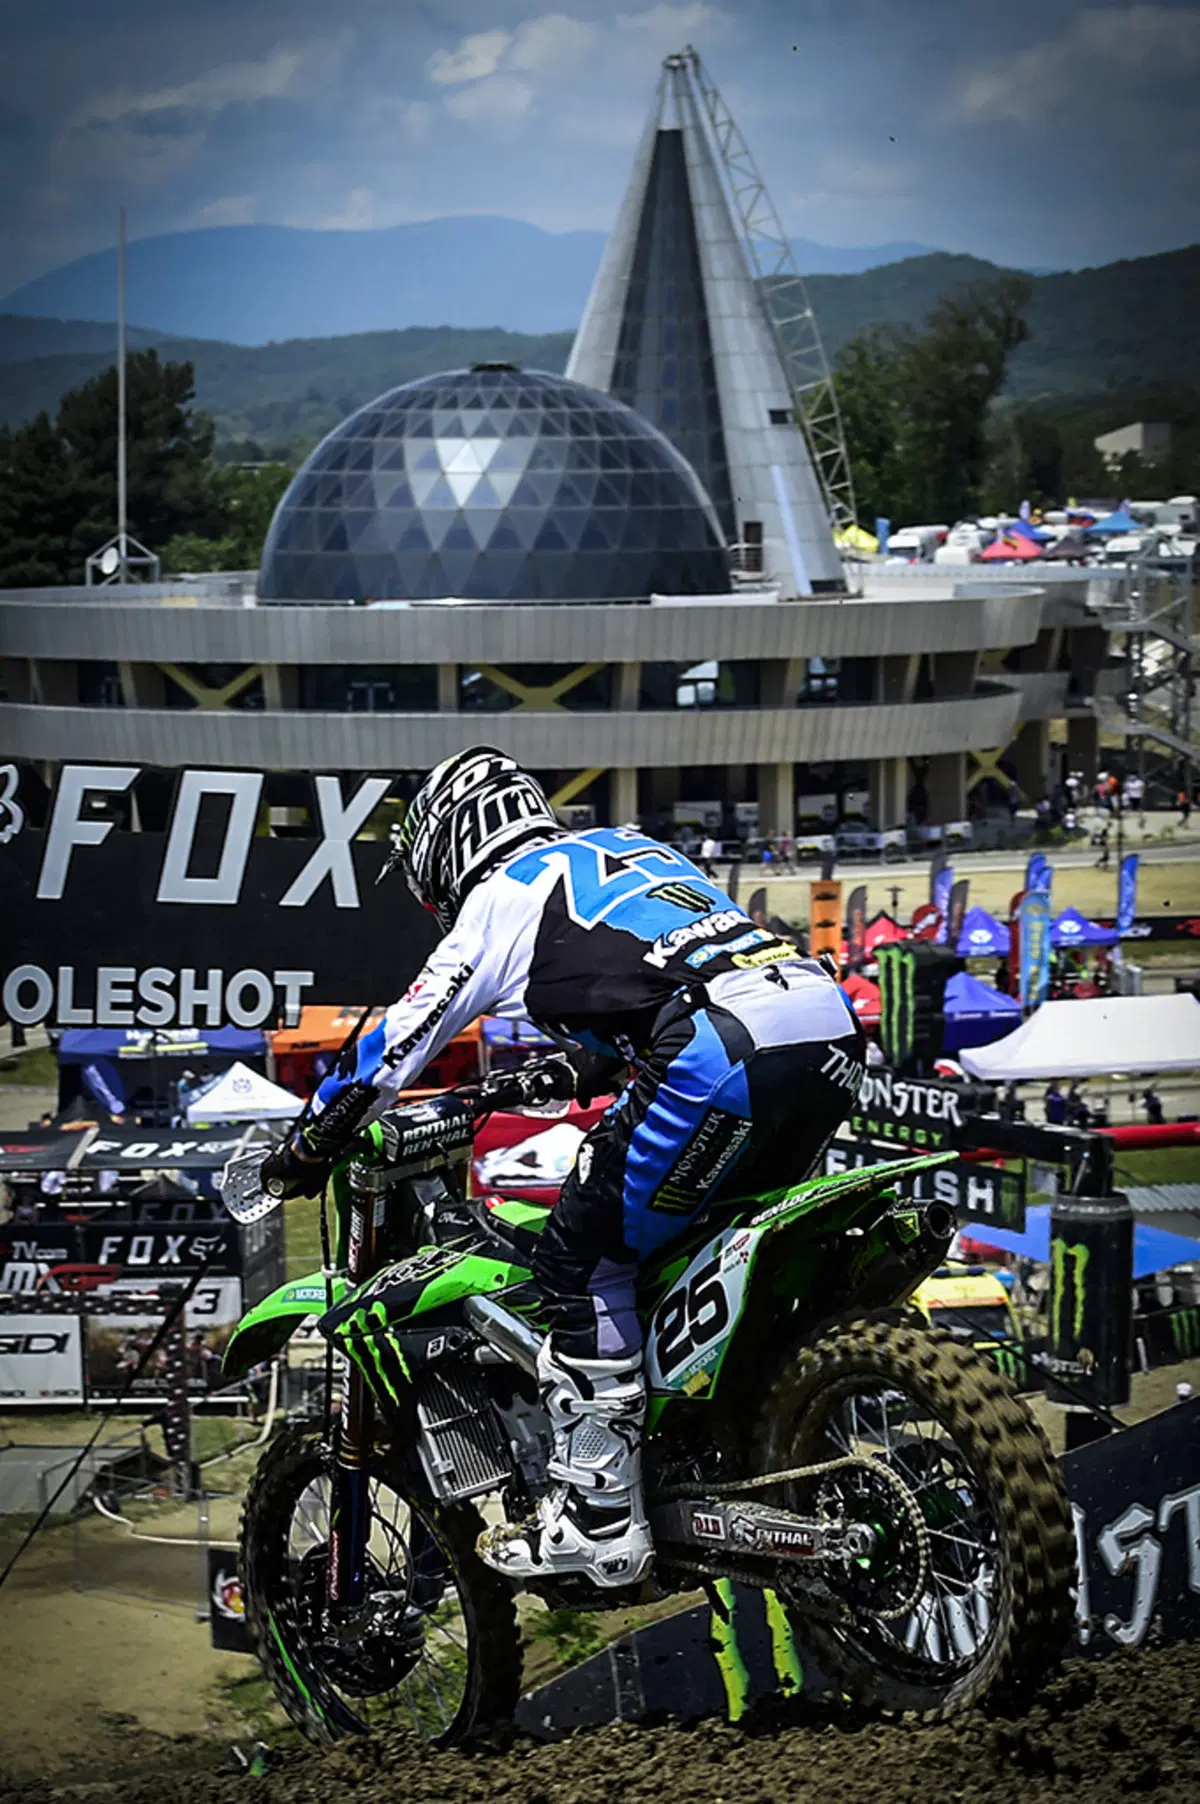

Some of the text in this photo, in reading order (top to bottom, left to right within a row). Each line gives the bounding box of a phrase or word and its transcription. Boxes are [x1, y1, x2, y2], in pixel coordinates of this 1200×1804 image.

[36, 765, 391, 907] FOX
[382, 962, 474, 1070] Kawasaki
[403, 1113, 470, 1142] RENTHAL
[858, 1068, 963, 1127] ONSTER
[87, 1140, 197, 1158] FOX
[669, 1112, 726, 1184] MONSTER
[696, 1119, 753, 1189] Kawasaki
[853, 1116, 943, 1145] ENERGY
[99, 1235, 187, 1265] FOX
[652, 1254, 730, 1379] 25
